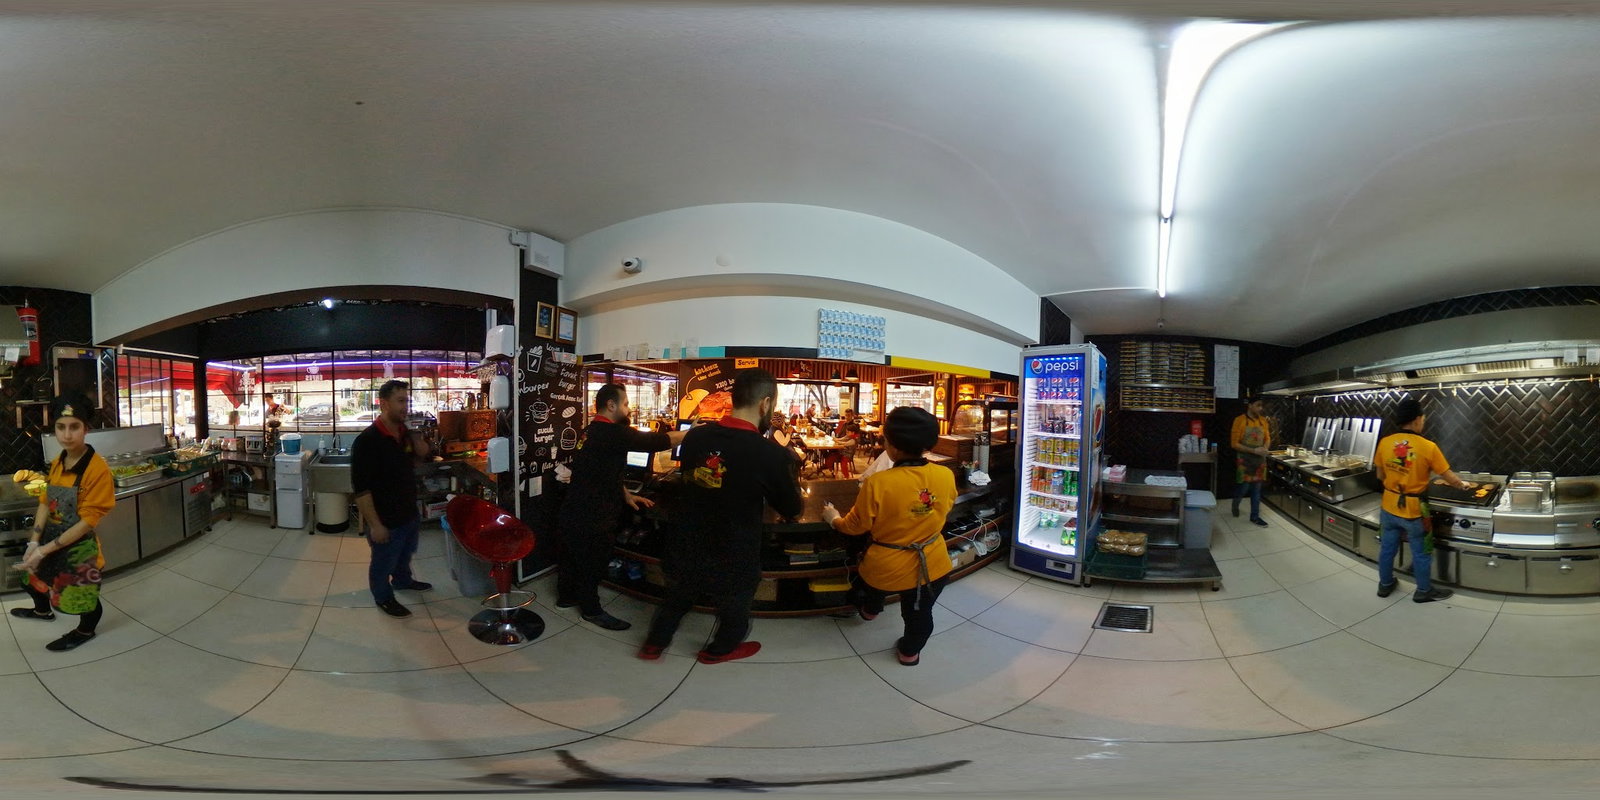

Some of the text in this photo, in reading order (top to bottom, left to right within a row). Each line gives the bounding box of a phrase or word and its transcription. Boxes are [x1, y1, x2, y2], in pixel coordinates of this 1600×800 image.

[1045, 360, 1079, 374] pepsi
[558, 378, 577, 392] burger
[537, 423, 554, 435] sucuk
[534, 434, 555, 443] burger
